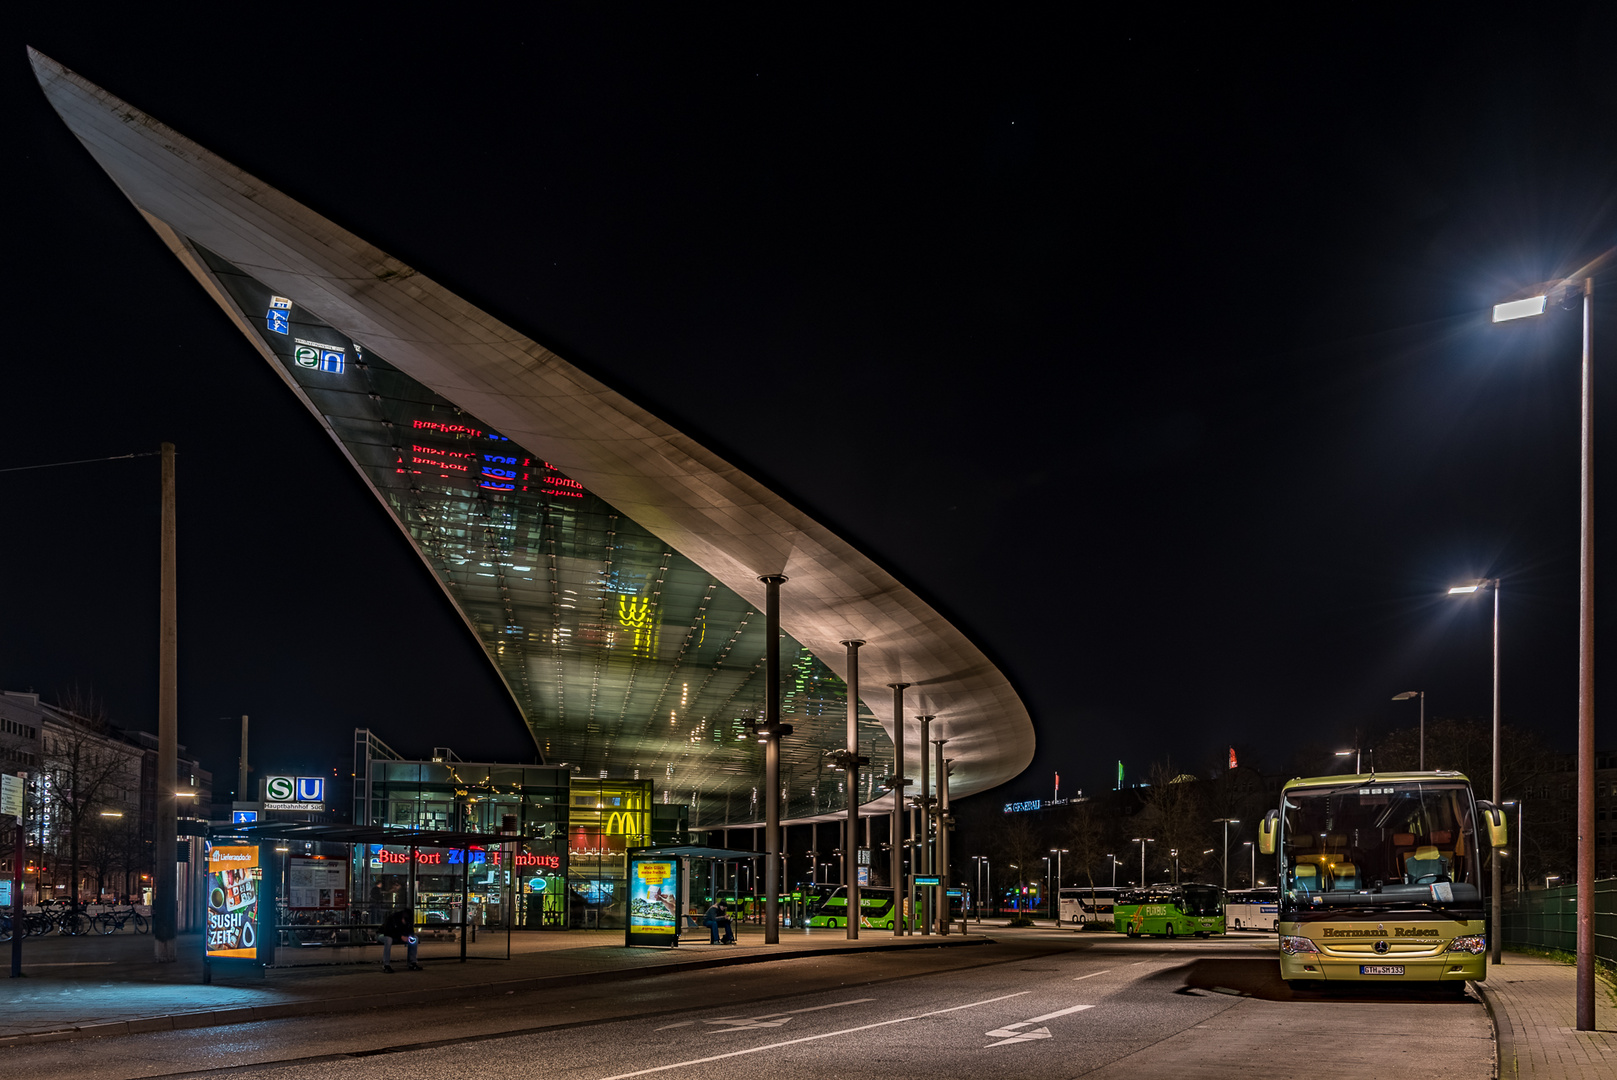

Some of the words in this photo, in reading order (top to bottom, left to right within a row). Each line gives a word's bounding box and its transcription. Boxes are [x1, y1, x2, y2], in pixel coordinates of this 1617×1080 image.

[271, 779, 289, 799] S
[300, 779, 320, 800] U
[264, 802, 309, 810] Hauptbahnhof
[493, 852, 559, 869] Hmburg
[211, 913, 242, 929] SUSHI
[210, 929, 233, 945] ZEIT
[1322, 928, 1389, 938] Herrmann
[1394, 927, 1439, 937] Reisen
